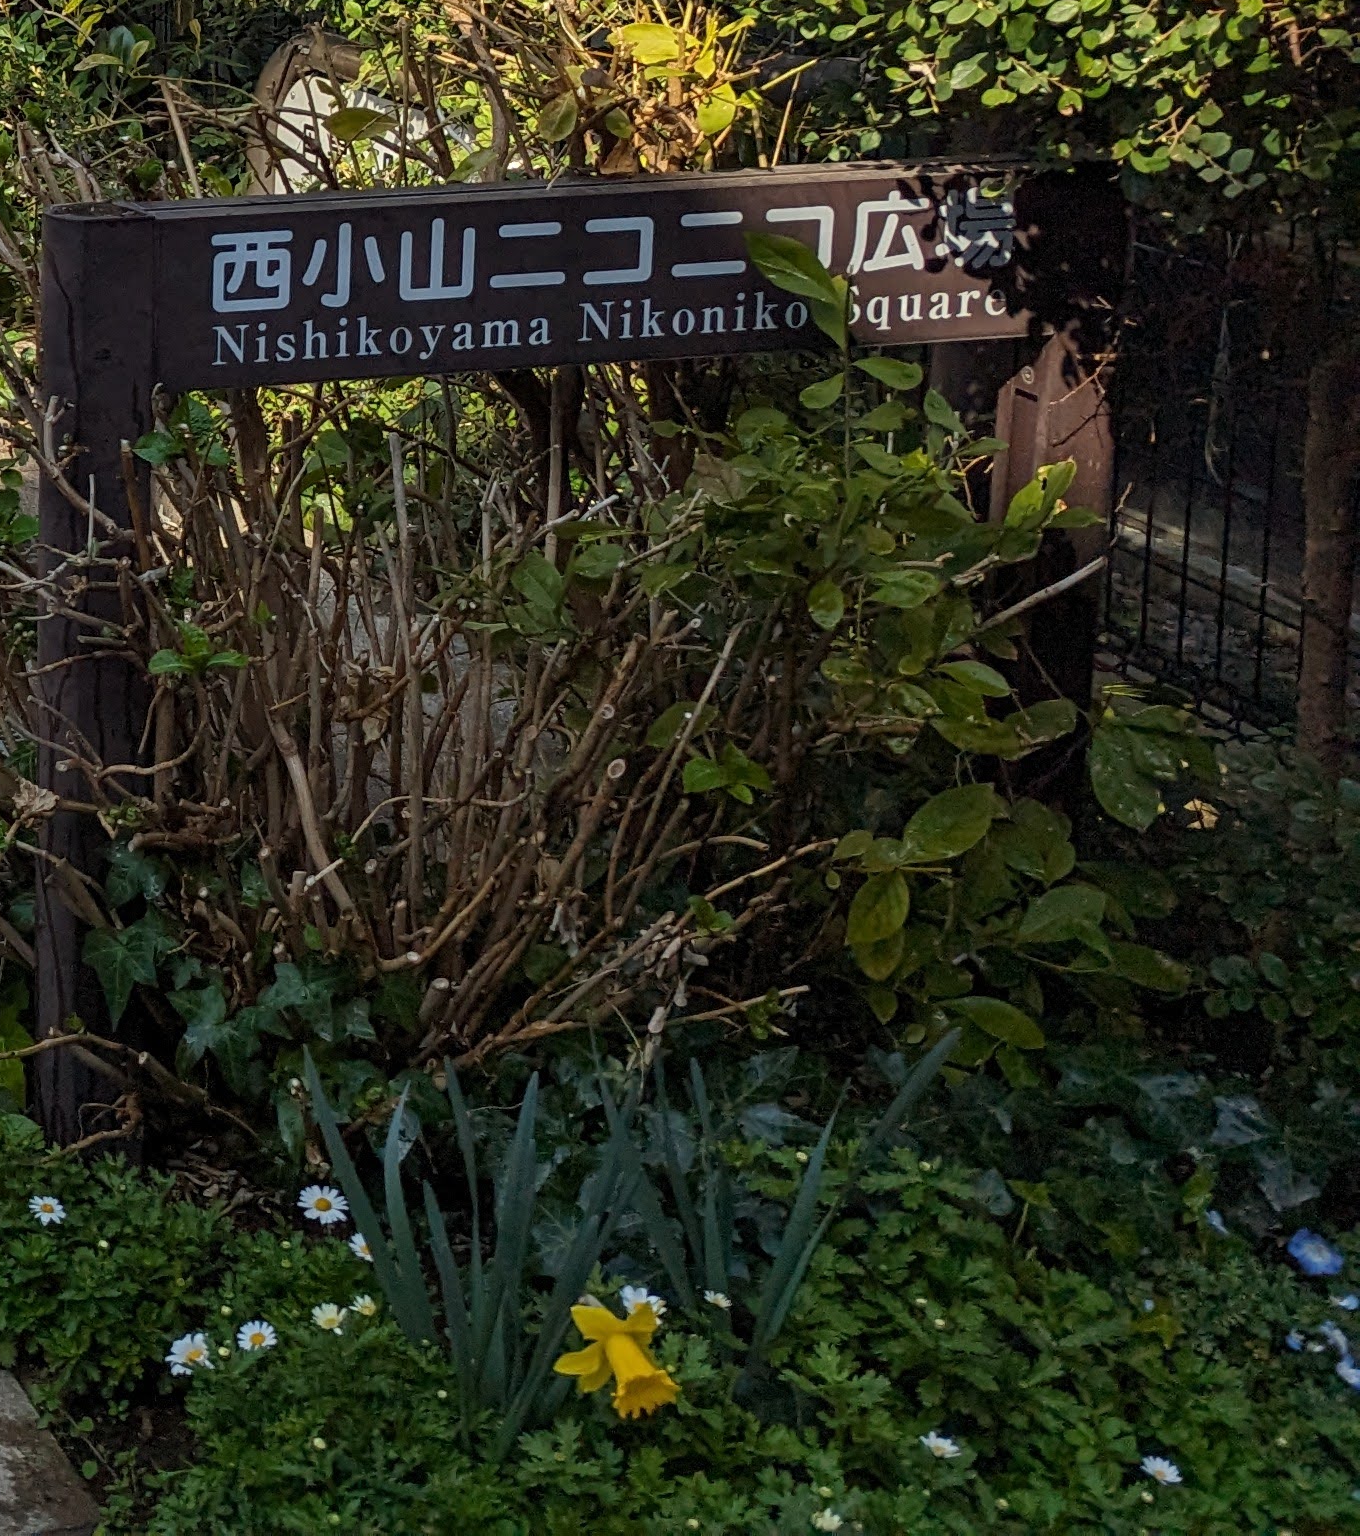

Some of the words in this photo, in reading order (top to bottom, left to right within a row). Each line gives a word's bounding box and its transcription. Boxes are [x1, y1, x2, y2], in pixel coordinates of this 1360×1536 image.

[210, 186, 1018, 314] 西小山ニコニコ広場
[210, 315, 553, 366] Nishikoyama
[578, 290, 809, 344] Nikoniko
